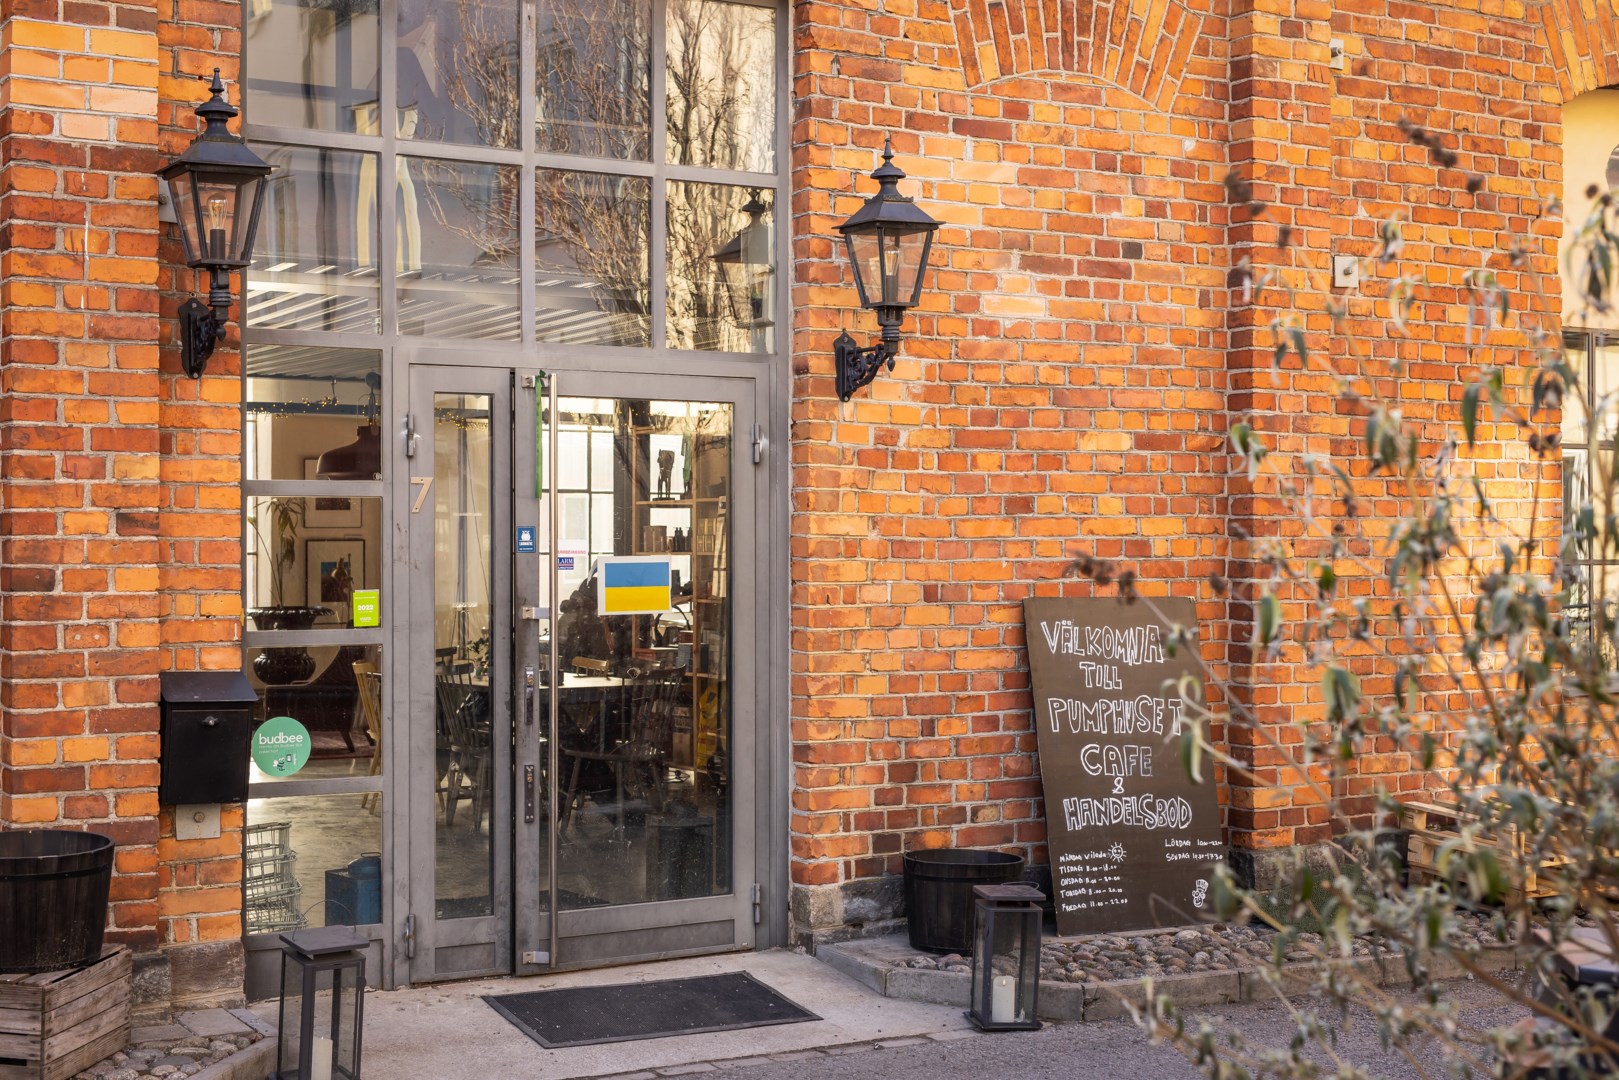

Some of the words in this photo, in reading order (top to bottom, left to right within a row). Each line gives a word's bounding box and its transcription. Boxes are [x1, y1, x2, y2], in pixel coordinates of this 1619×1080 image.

[410, 476, 434, 513] 7
[1040, 620, 1164, 666] VÄLKOMNA
[1079, 662, 1122, 690] TILL
[1048, 695, 1183, 736] PUMPHUSET
[258, 732, 303, 744] budbee
[1080, 744, 1153, 777] CAFE
[1112, 776, 1124, 794] &
[1062, 794, 1192, 831] HANDELSBOD
[1059, 865, 1083, 874] TISDAG
[1060, 878, 1083, 886] ONSDAG
[1060, 888, 1086, 898] TORSDAG
